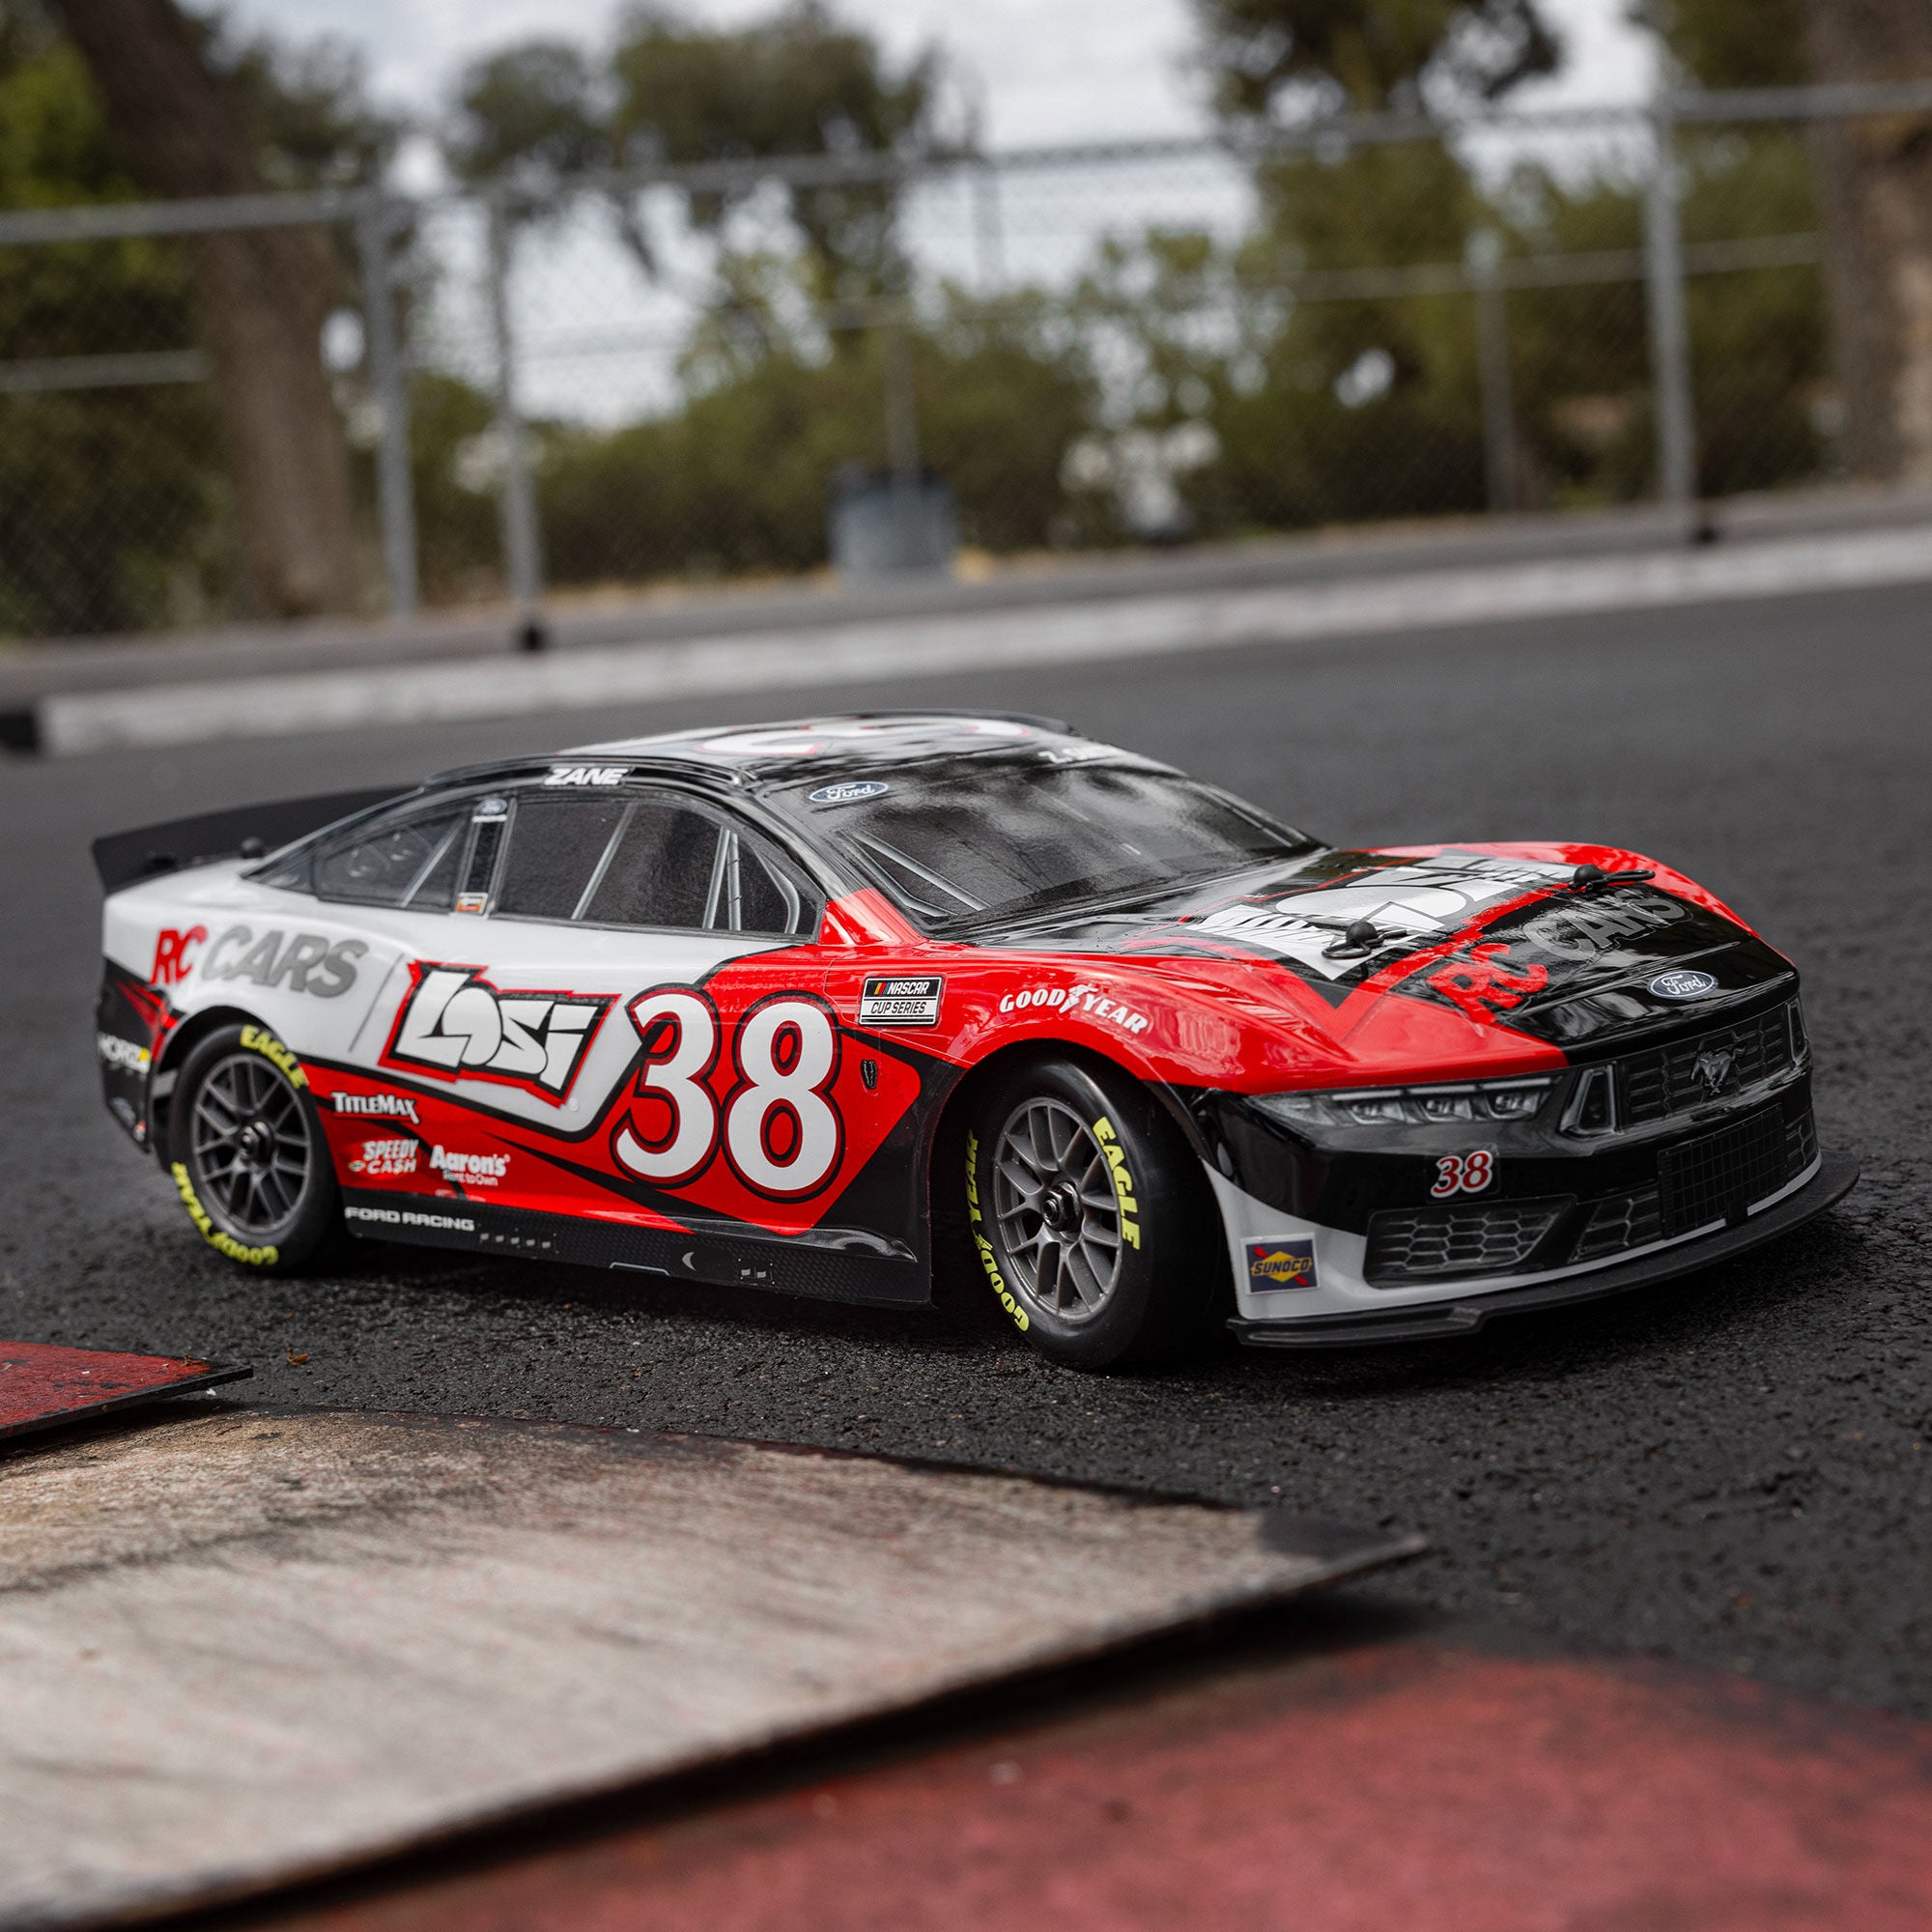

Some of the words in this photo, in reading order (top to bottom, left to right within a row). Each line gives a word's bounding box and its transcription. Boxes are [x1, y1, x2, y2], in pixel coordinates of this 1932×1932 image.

[544, 767, 630, 786] ZANE
[826, 781, 876, 801] Ford
[149, 924, 208, 986] RC
[201, 924, 371, 999] CARS
[886, 980, 930, 996] NASCAR
[1426, 943, 1549, 1025] RC
[1662, 974, 1708, 998] Ford
[869, 1001, 890, 1014] CUP
[892, 1001, 926, 1015] SERIES
[240, 1024, 309, 1089] EAGLE
[612, 987, 841, 1198] 38
[363, 1139, 419, 1161] SPEEDY
[429, 1145, 507, 1177] Aaron's
[1092, 1116, 1141, 1251] EAGLE
[1430, 1150, 1494, 1199] 38
[344, 1208, 401, 1223] FORD
[402, 1212, 475, 1232] RACING
[1250, 1258, 1314, 1277] SUNOCO
